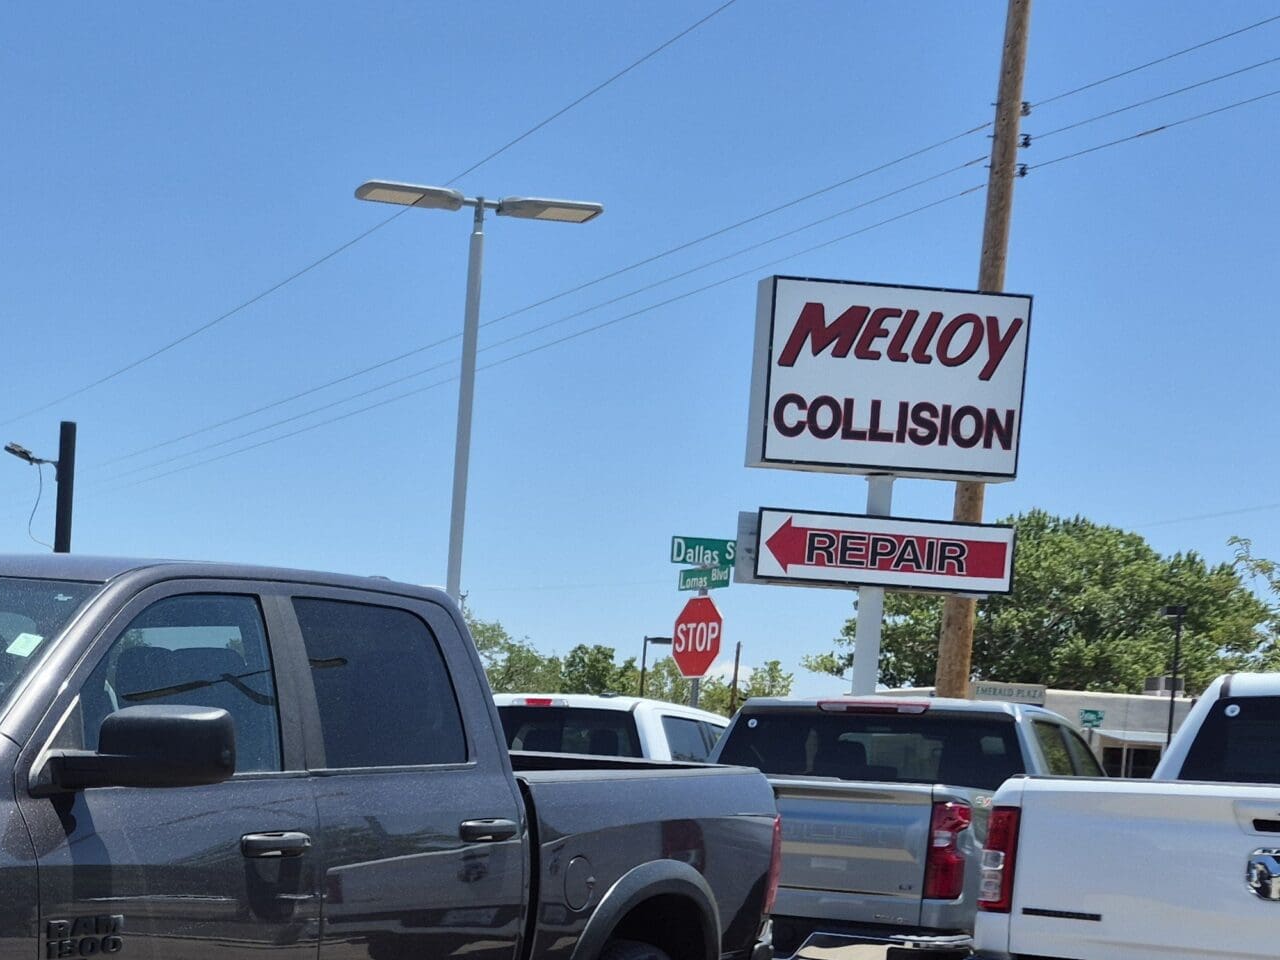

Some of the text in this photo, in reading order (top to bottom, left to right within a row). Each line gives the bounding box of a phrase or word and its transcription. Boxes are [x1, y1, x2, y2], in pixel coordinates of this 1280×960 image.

[778, 302, 1023, 381] MELLOY
[773, 393, 1016, 451] COLLISION
[673, 538, 737, 564] Dallas S
[805, 530, 968, 576] REPAIR
[680, 567, 729, 589] Lomas Blvd
[675, 621, 720, 653] STOP
[975, 686, 1014, 697] EMERALD
[46, 914, 124, 940] RAM
